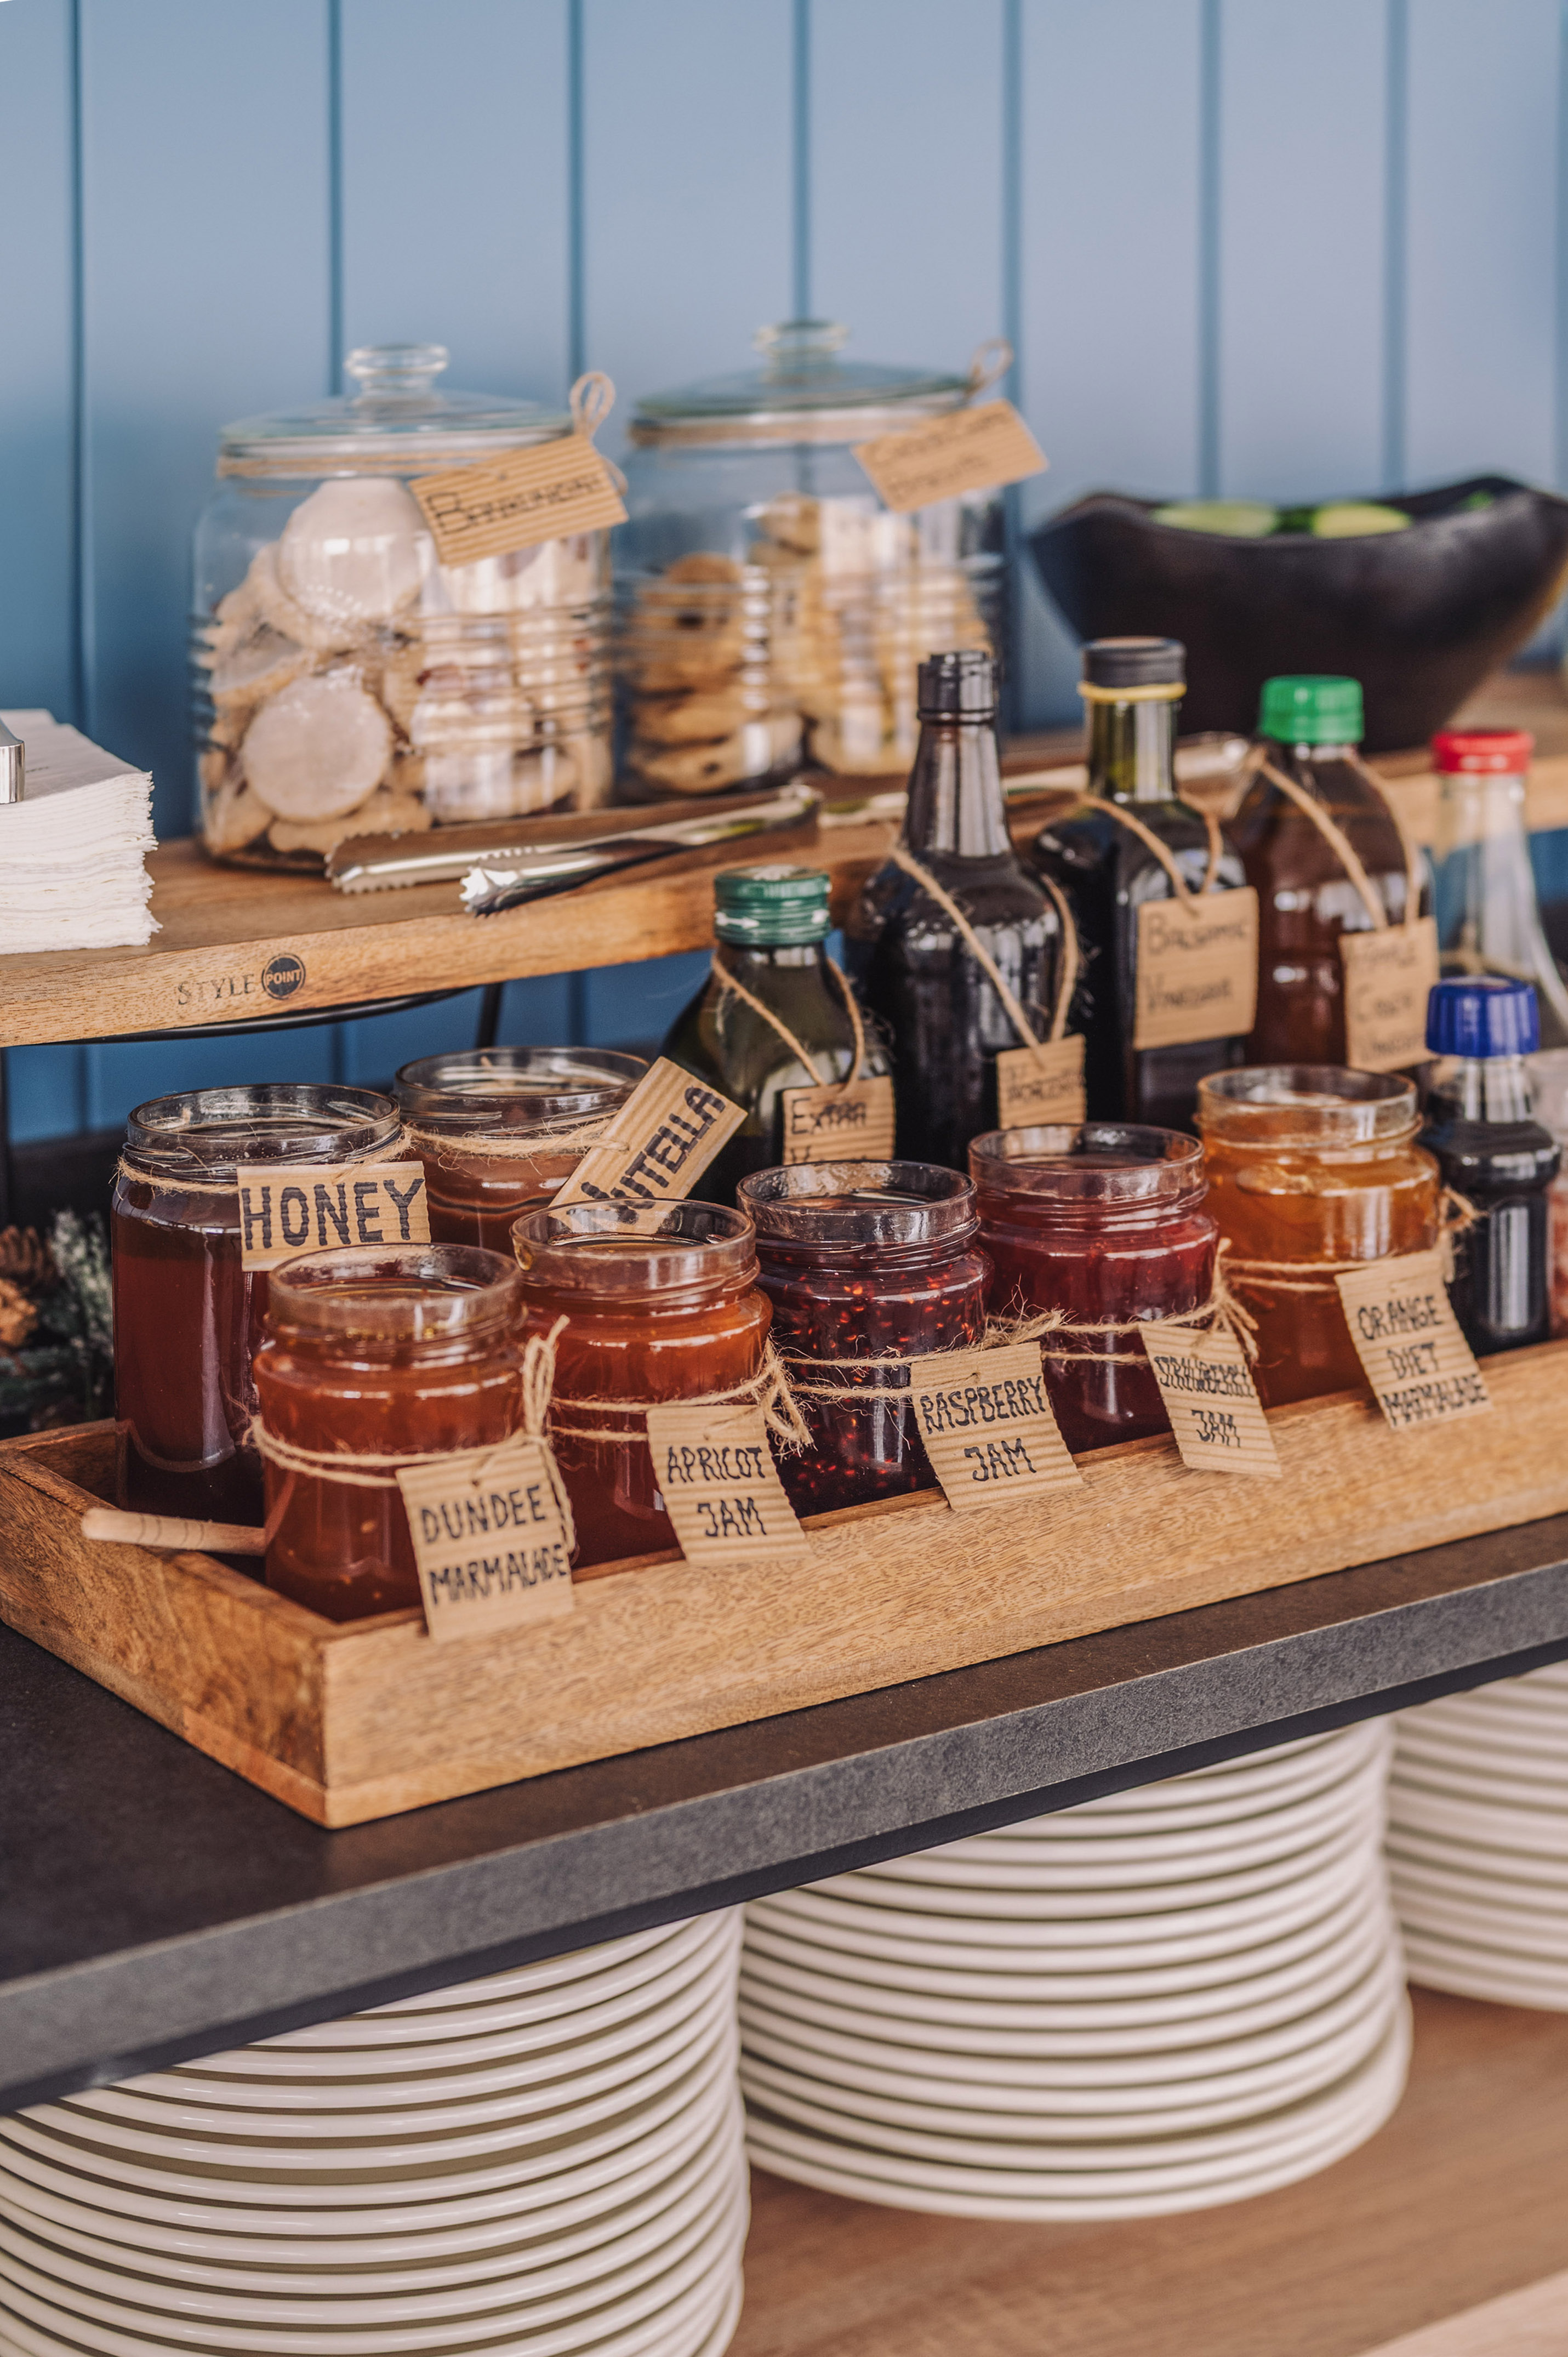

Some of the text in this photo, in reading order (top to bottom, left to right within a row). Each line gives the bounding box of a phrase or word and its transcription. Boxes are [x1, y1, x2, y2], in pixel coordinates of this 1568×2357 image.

[178, 969, 301, 1005] STYLE POINT
[242, 1178, 424, 1250] HONEY
[1358, 1295, 1444, 1340] ORANGE
[1387, 1342, 1439, 1380] DIET
[920, 1376, 1046, 1434] RASPBERRY
[1191, 1409, 1241, 1448] JAM
[668, 1446, 766, 1483] APRICOT
[963, 1438, 1036, 1482] JAM
[421, 1485, 546, 1544] DUNDEE
[697, 1497, 767, 1537] JAM
